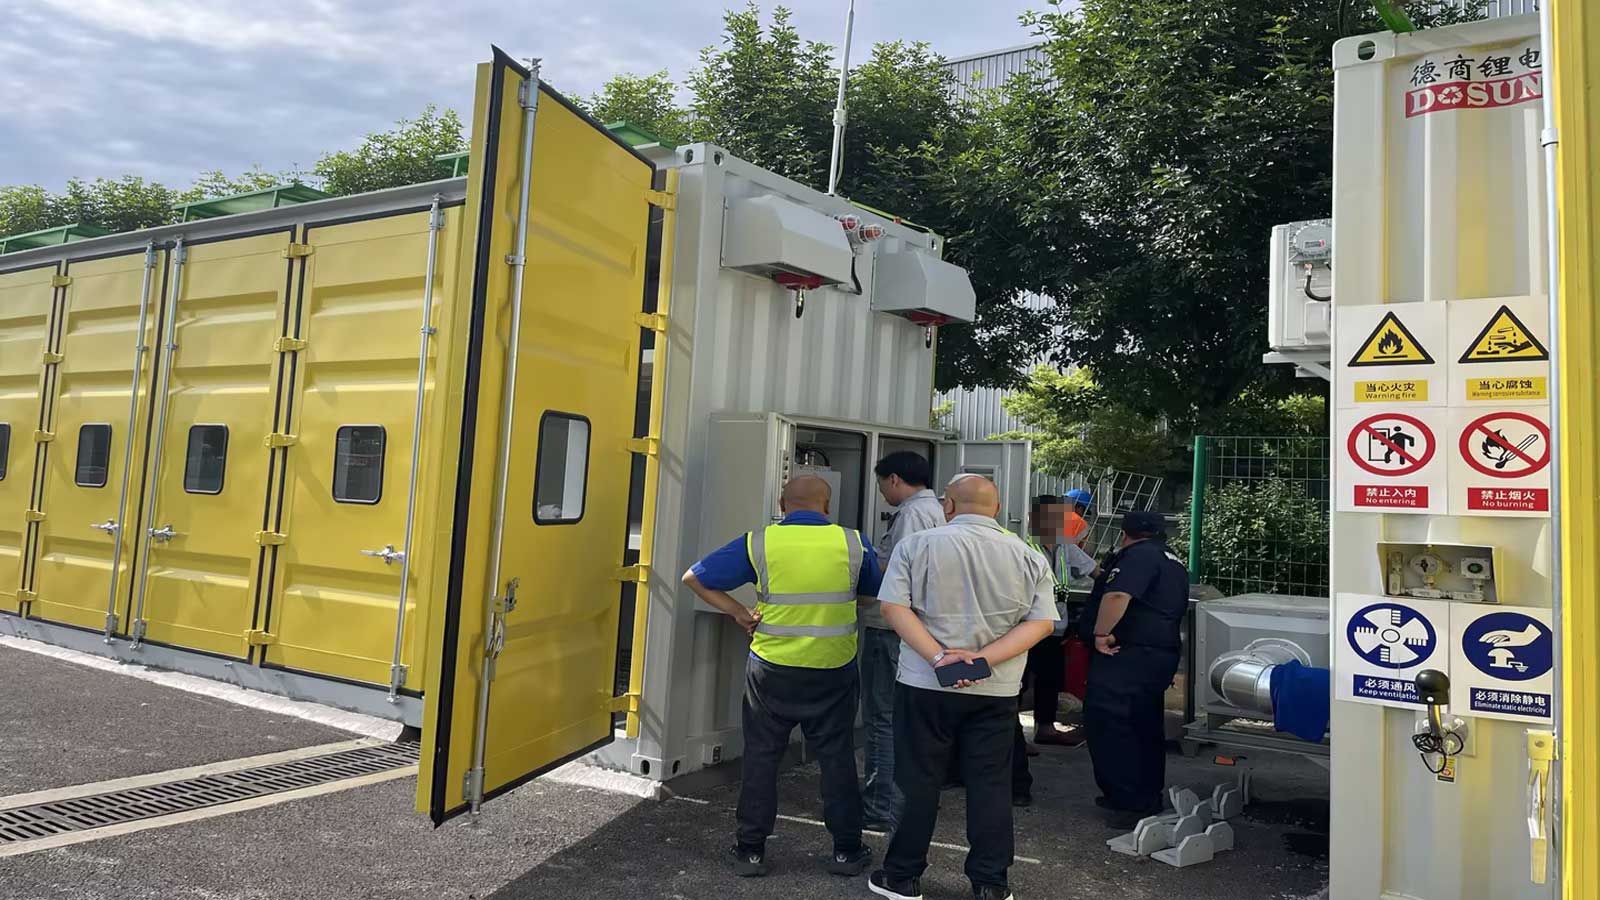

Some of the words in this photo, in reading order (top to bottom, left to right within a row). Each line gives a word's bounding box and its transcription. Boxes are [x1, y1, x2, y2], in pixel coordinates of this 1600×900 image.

[1410, 48, 1542, 87] 德商锂电
[1366, 382, 1415, 392] 当心火灾
[1479, 380, 1532, 390] 当心腐蚀
[1366, 487, 1416, 498] 禁止入内
[1480, 490, 1536, 501] 禁止烟火
[1379, 498, 1416, 506] entering
[1497, 500, 1534, 509] burning
[1364, 678, 1416, 693] 必须通风
[1358, 687, 1378, 696] Keep
[1475, 690, 1546, 707] 必须消除静电
[1474, 700, 1500, 709] Eliminate
[1517, 705, 1546, 715] electricity
